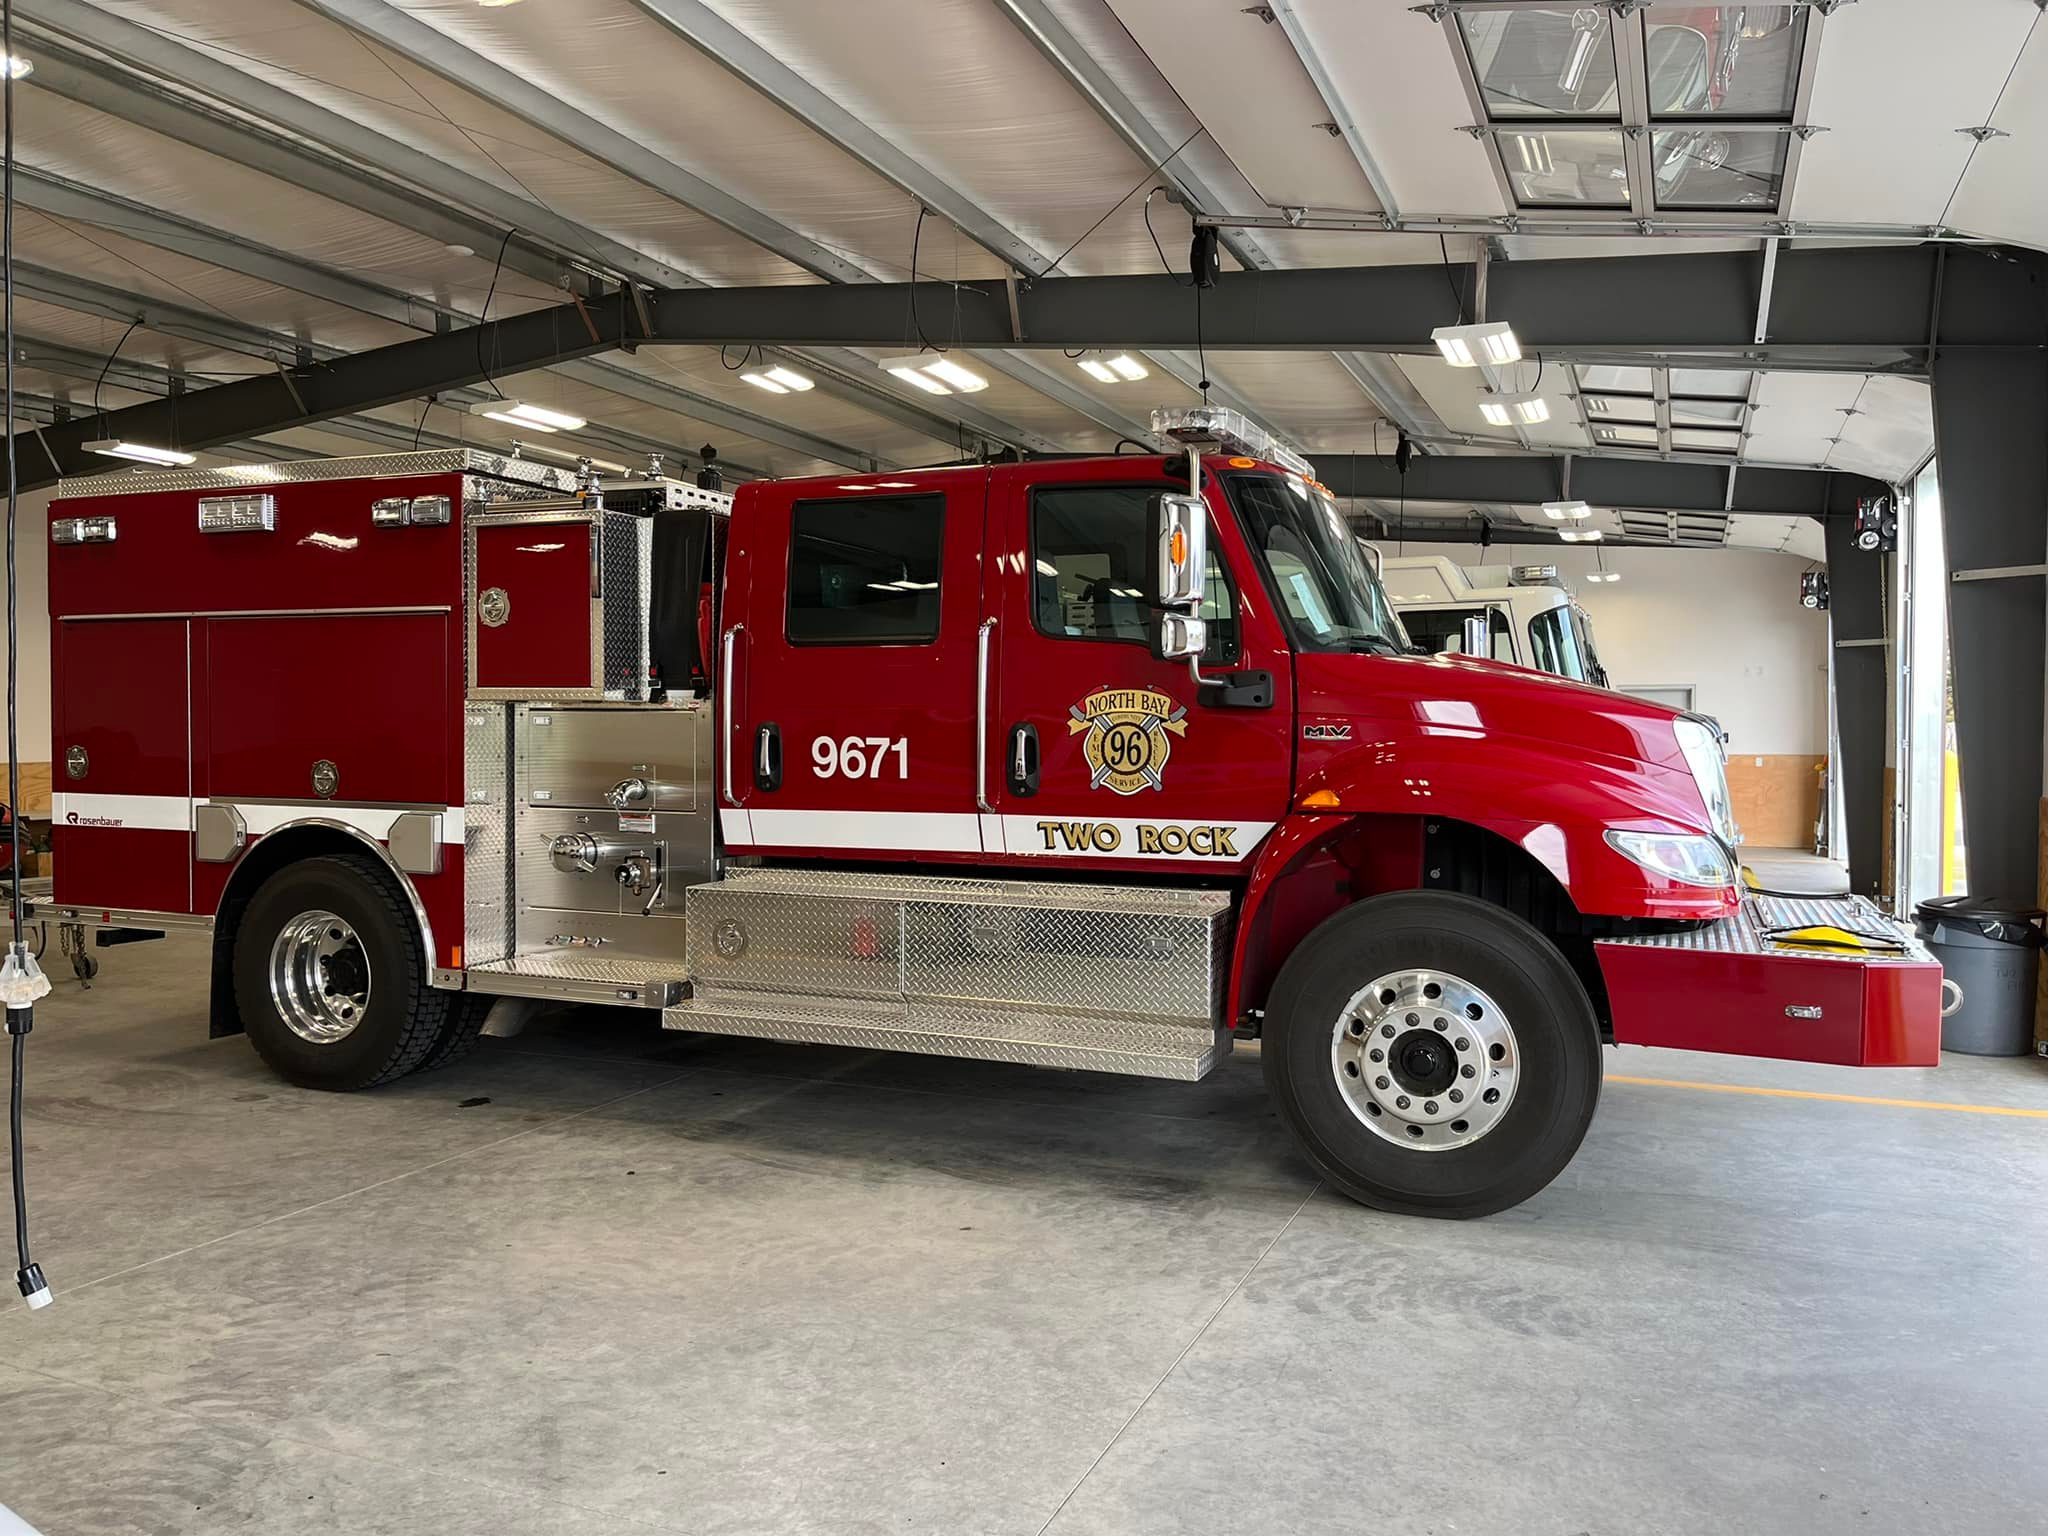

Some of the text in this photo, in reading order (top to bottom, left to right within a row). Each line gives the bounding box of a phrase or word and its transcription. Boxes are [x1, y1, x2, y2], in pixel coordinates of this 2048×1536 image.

[1088, 692, 1167, 716] NORTH BAY
[1303, 725, 1352, 738] MV
[811, 735, 908, 779] 9671
[1092, 734, 1100, 762] EMS
[1110, 730, 1141, 766] 96
[1109, 775, 1141, 787] SERVICE
[79, 816, 123, 827] rosenbauer
[1037, 821, 1239, 856] TWO ROCK
